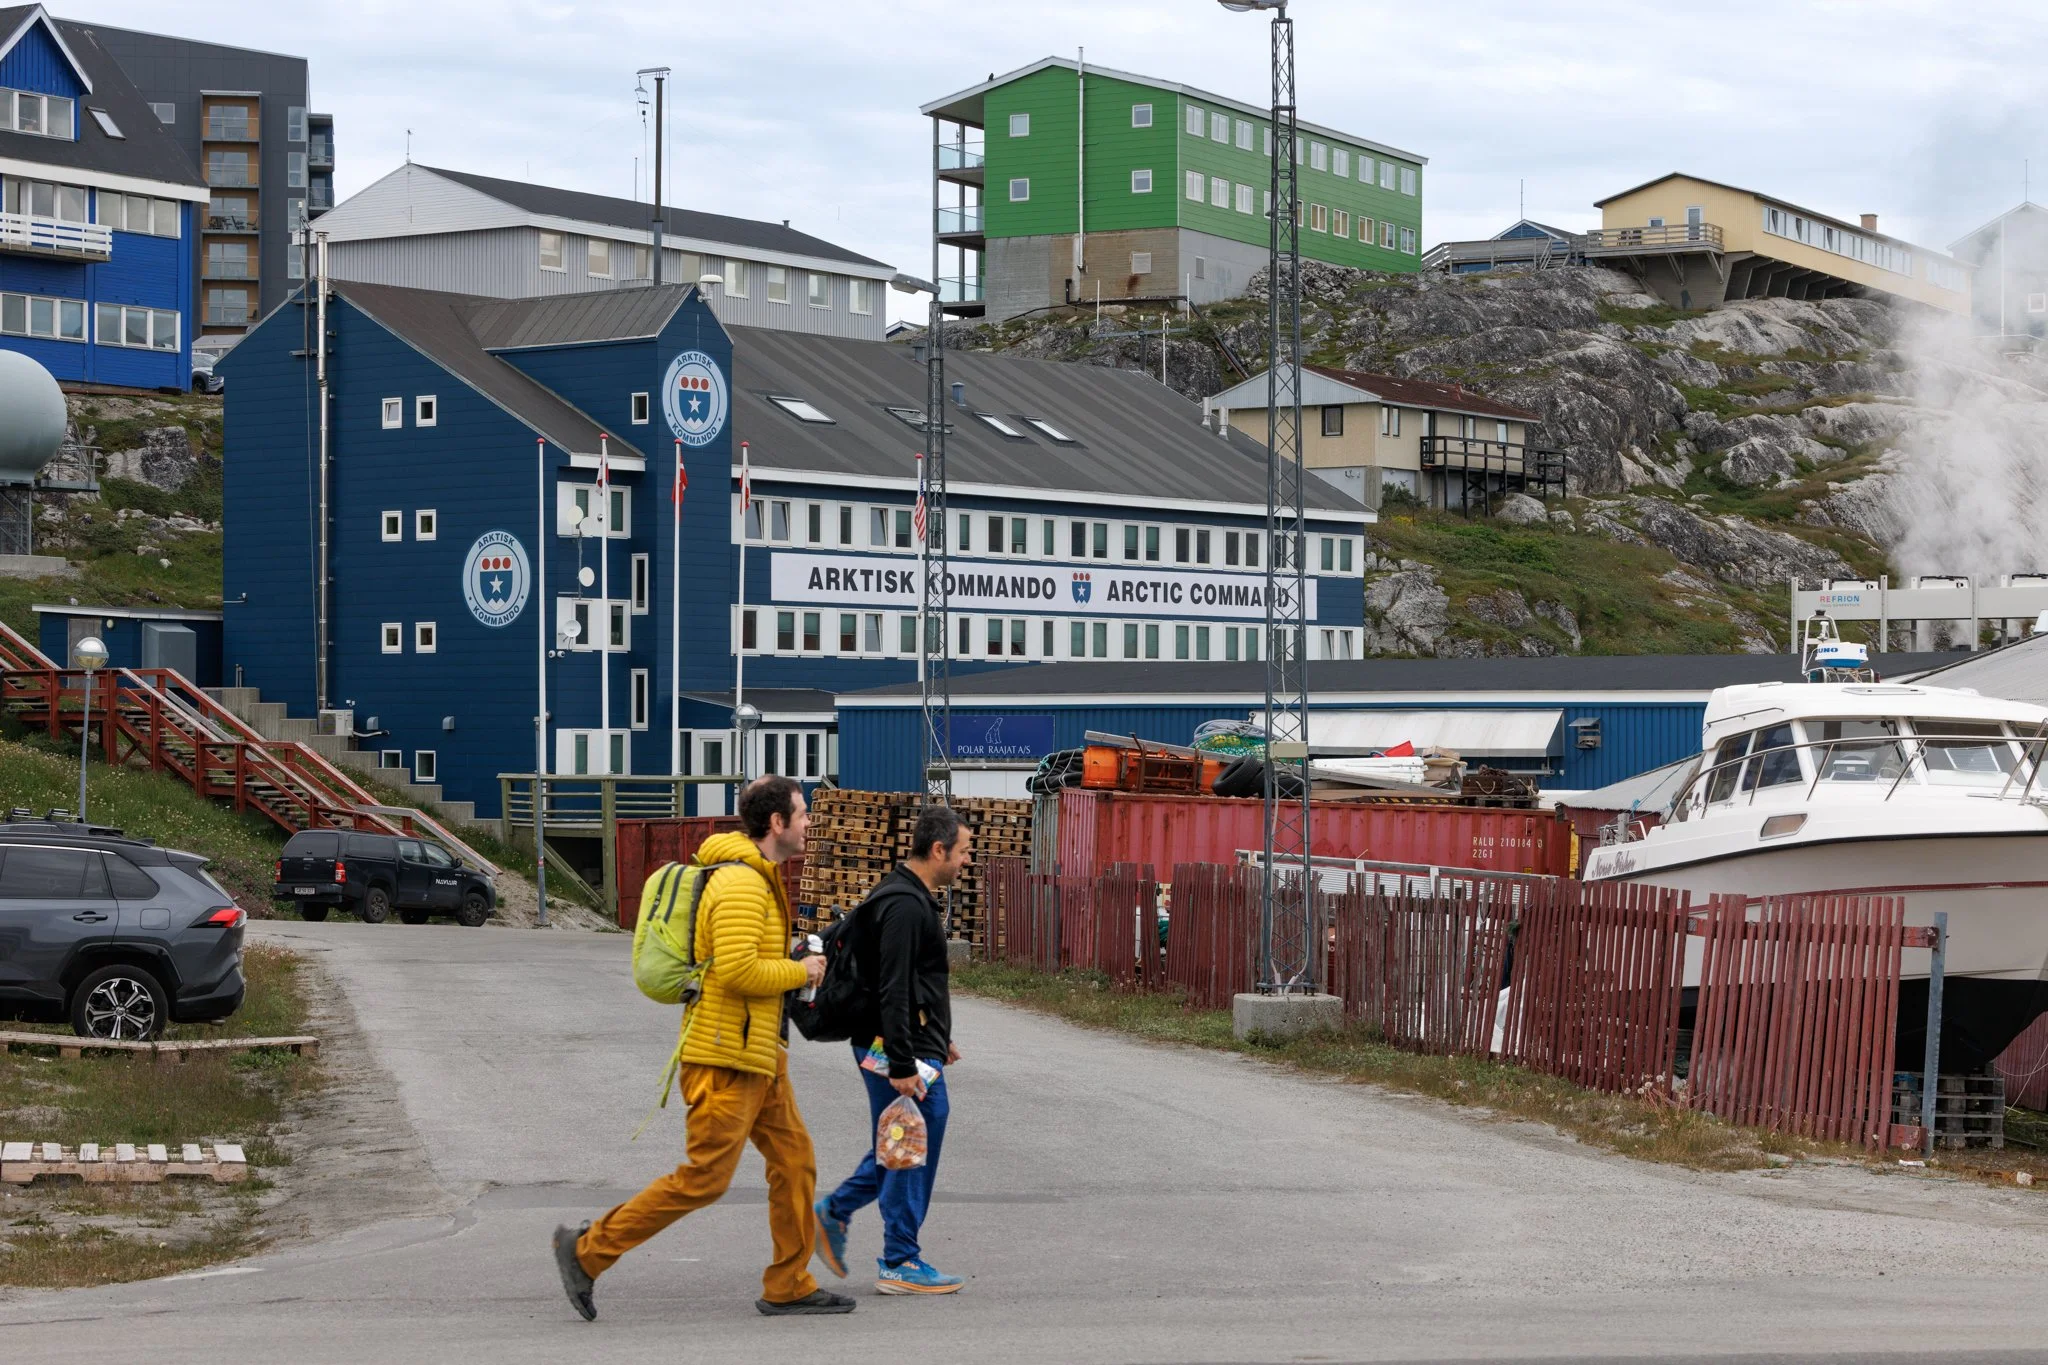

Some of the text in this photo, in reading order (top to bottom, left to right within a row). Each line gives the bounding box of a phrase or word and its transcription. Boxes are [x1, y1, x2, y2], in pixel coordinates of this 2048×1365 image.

[677, 353, 712, 369] ARKTISK
[671, 423, 717, 445] KOMMANDO
[478, 533, 515, 549] ARKTISK
[808, 566, 915, 594] ARKTISK
[1107, 580, 1183, 604] ARCTIC
[1820, 595, 1860, 603] REFRION
[473, 605, 520, 626] KOMMANDO
[958, 745, 1031, 755] POLAR RAAJAT A/S
[1472, 837, 1494, 847] RALU
[1500, 837, 1531, 848] 210184
[880, 1269, 902, 1282] HOKA
